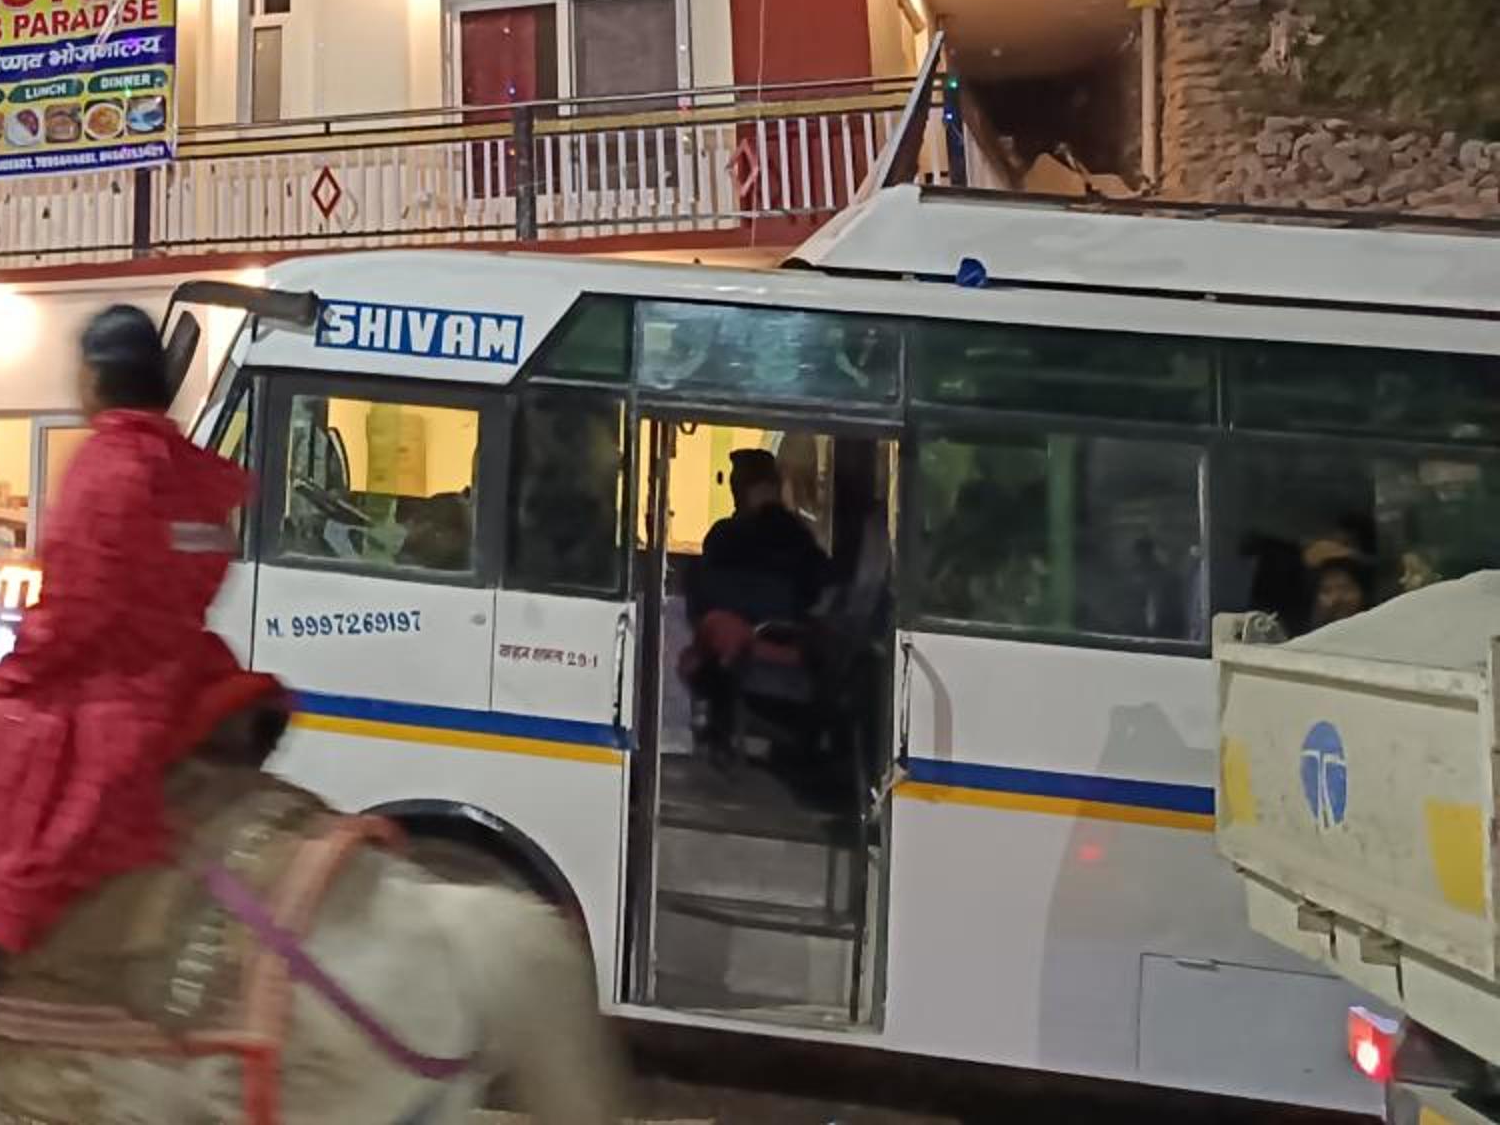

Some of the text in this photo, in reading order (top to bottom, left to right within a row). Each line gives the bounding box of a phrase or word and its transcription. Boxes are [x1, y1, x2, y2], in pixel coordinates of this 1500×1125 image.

[24, 83, 67, 100] LUNCH
[100, 73, 151, 90] DINNER
[322, 303, 519, 361] SHIVAM
[291, 610, 422, 638] 9997269197
